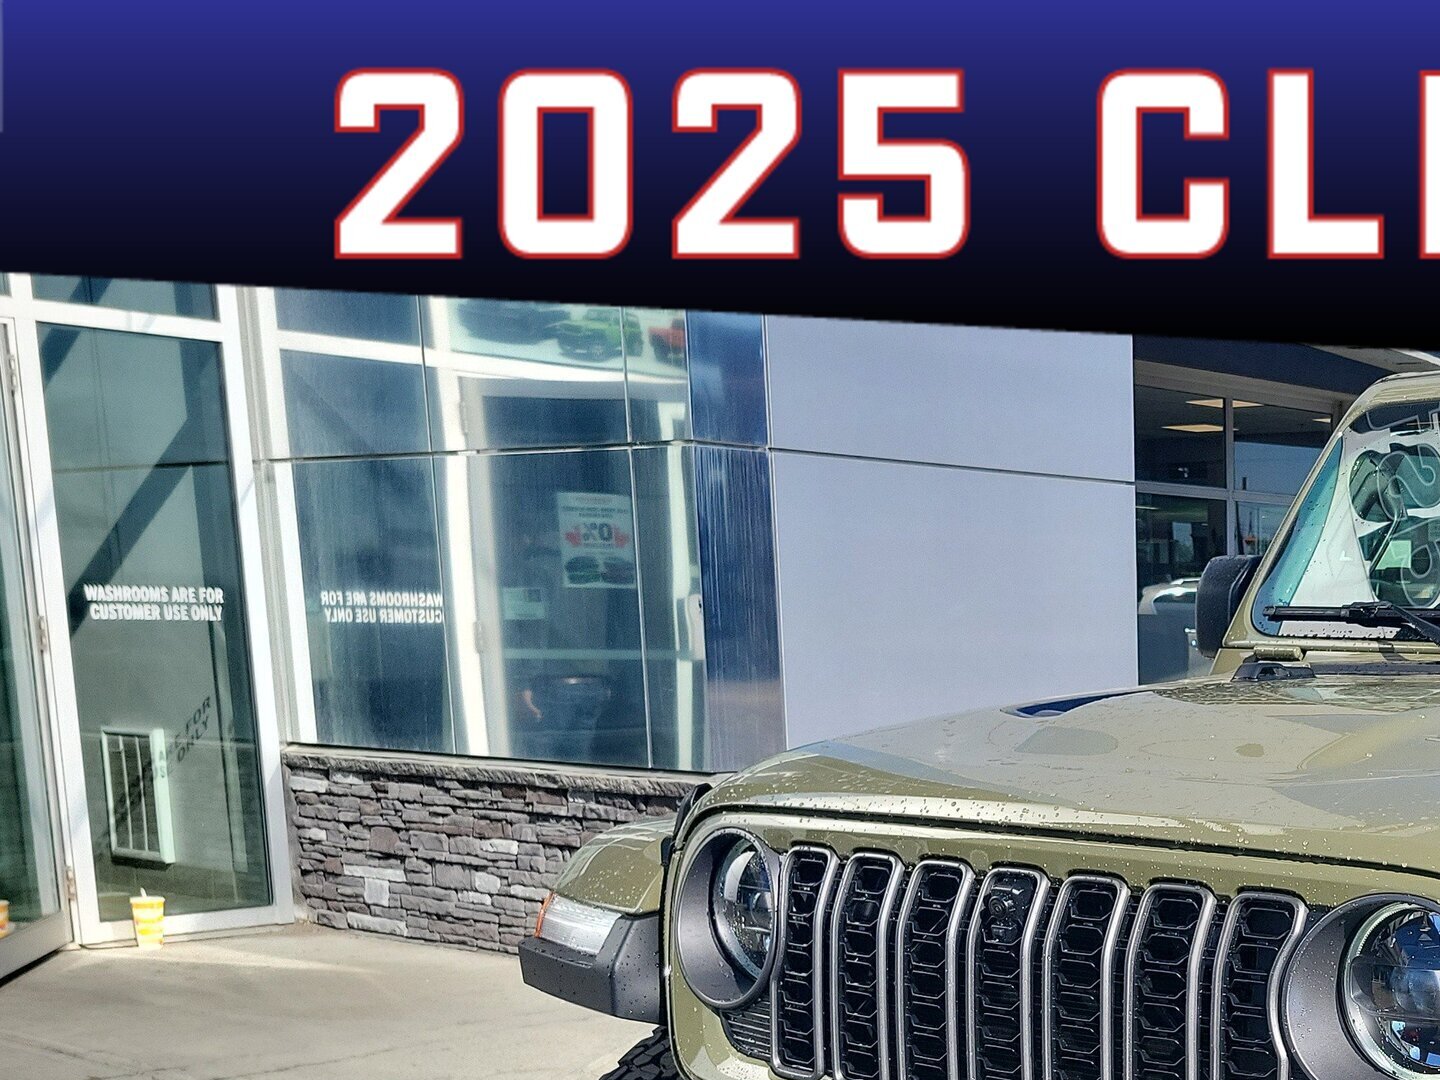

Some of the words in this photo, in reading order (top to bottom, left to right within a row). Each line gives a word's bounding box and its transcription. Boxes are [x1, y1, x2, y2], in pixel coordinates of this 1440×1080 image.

[84, 583, 169, 602] WASHROOMS
[171, 586, 197, 603] ARE
[200, 587, 225, 604] FOR
[89, 603, 161, 621] CUSTOMER
[163, 604, 190, 621] USE
[191, 604, 223, 622] ONLY
